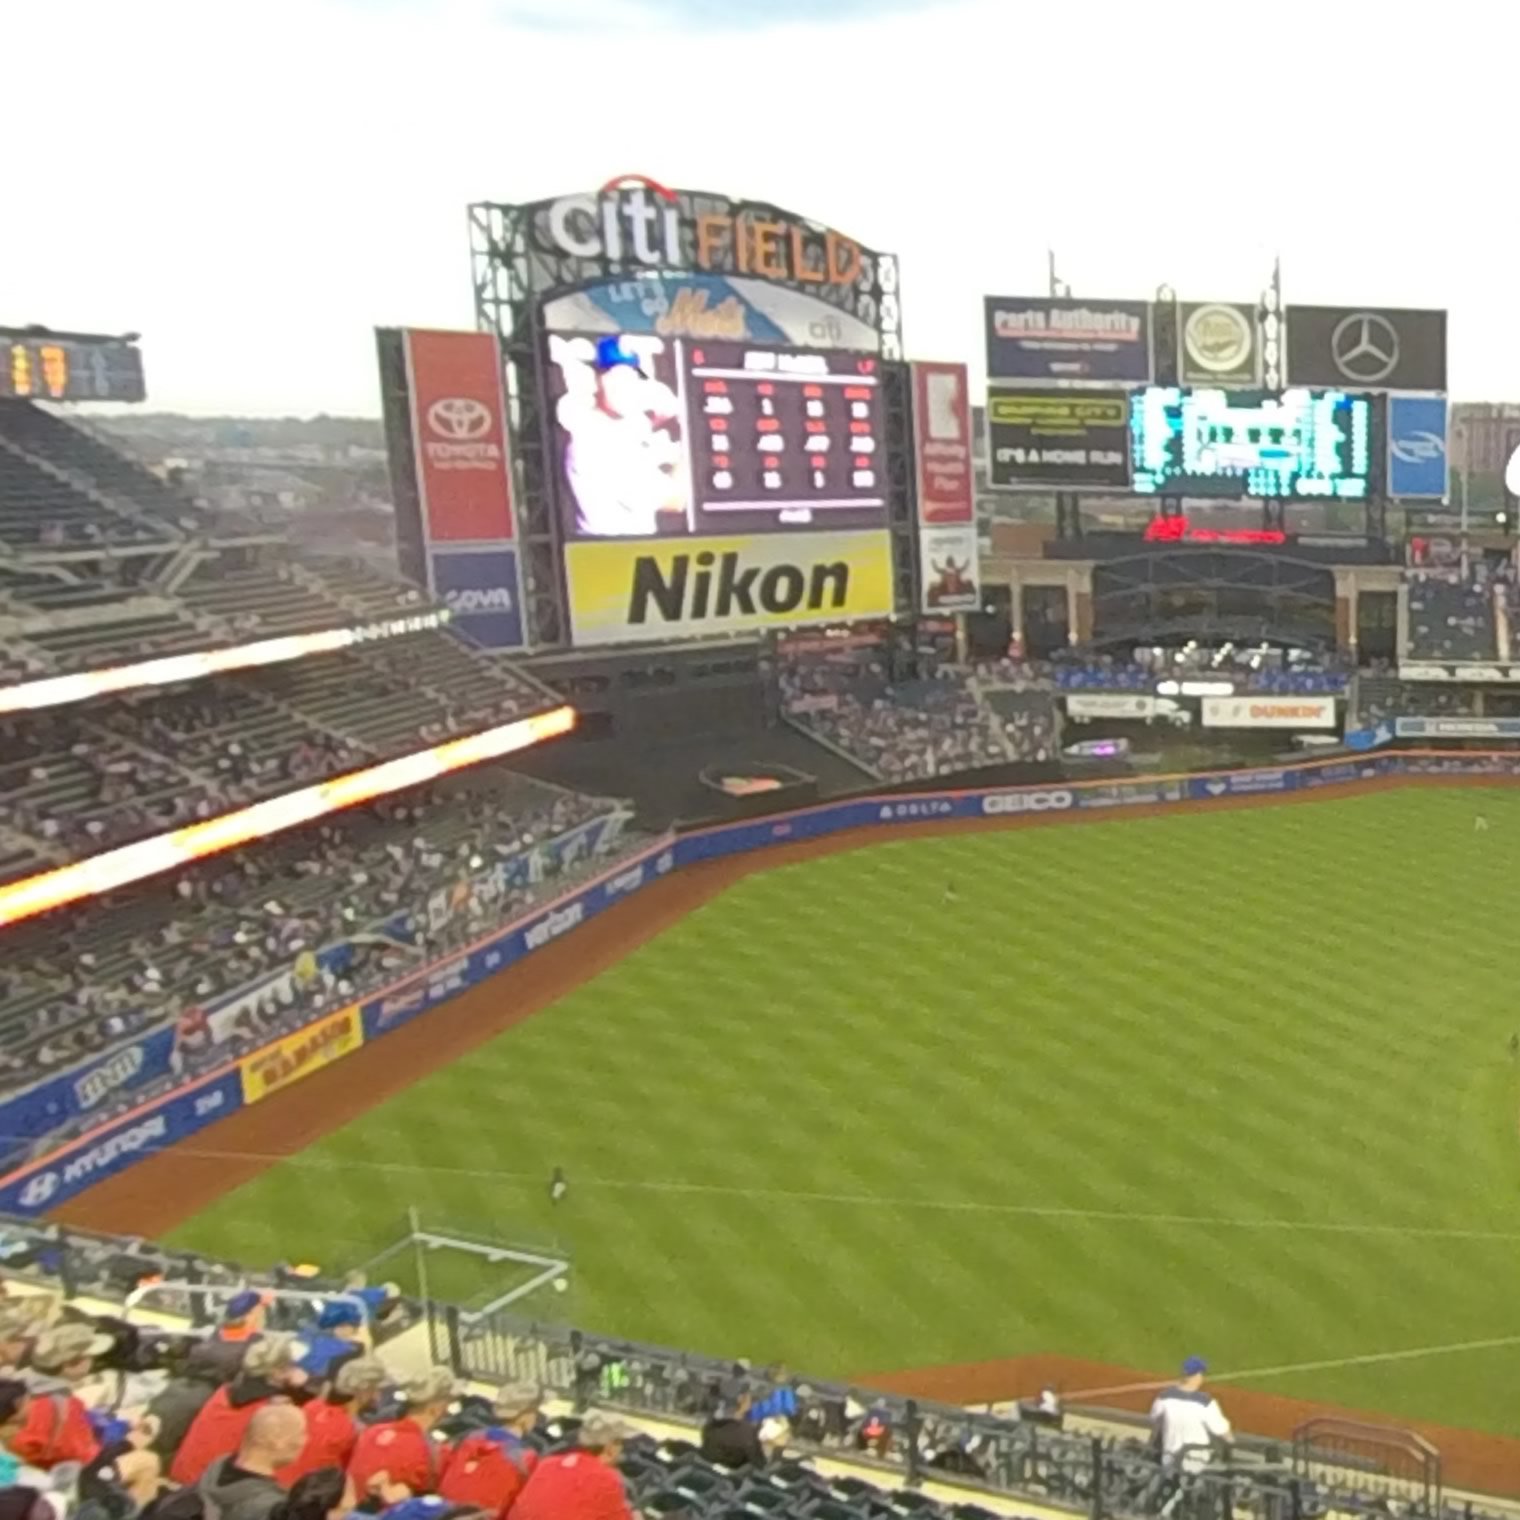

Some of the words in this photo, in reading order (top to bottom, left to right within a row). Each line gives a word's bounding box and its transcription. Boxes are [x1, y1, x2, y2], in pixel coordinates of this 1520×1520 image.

[549, 190, 679, 265] citi
[695, 214, 862, 284] FIELD
[426, 442, 500, 460] TOYOTA
[627, 550, 849, 625] Nikon
[896, 801, 952, 817] DELTA
[982, 790, 1072, 814] GEICO
[523, 902, 584, 950] verizon
[63, 1114, 167, 1183] HYUNDAI
